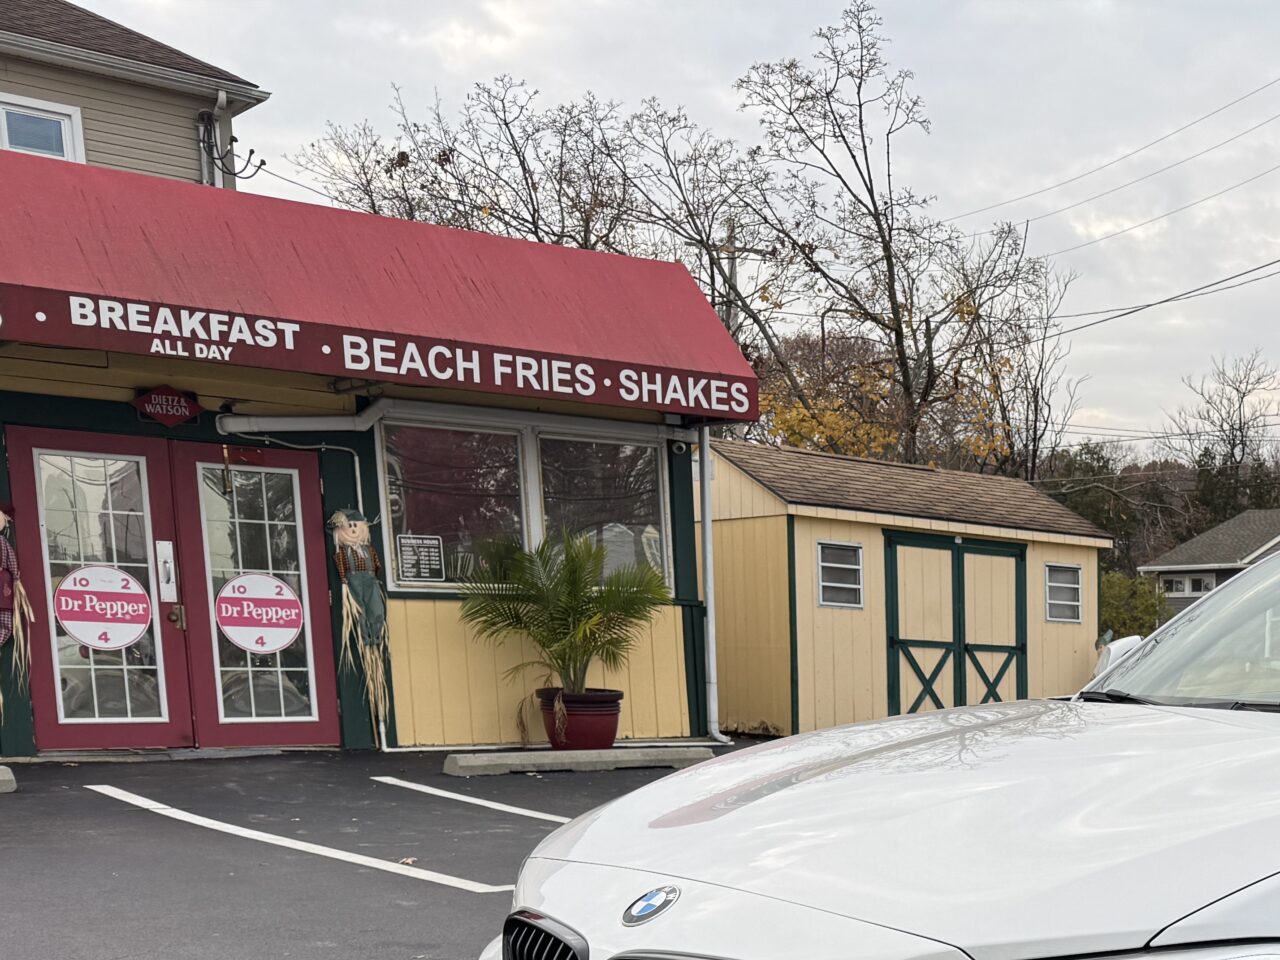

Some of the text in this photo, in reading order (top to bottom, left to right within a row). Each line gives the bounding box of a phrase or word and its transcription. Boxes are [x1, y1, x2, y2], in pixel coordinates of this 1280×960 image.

[69, 295, 300, 350] BREAKFAST
[150, 338, 233, 361] ALL DAY
[342, 334, 750, 413] BEACH FRIES SHAKES
[151, 394, 179, 406] DIETZ
[144, 403, 190, 416] WATSON
[73, 577, 90, 588] 10
[120, 578, 131, 590] 2
[232, 584, 247, 595] 10
[275, 585, 284, 596] 2
[60, 594, 147, 618] Dr Pepper
[220, 600, 299, 624] Dr Pepper
[98, 631, 110, 643] 4
[255, 635, 266, 647] 4
